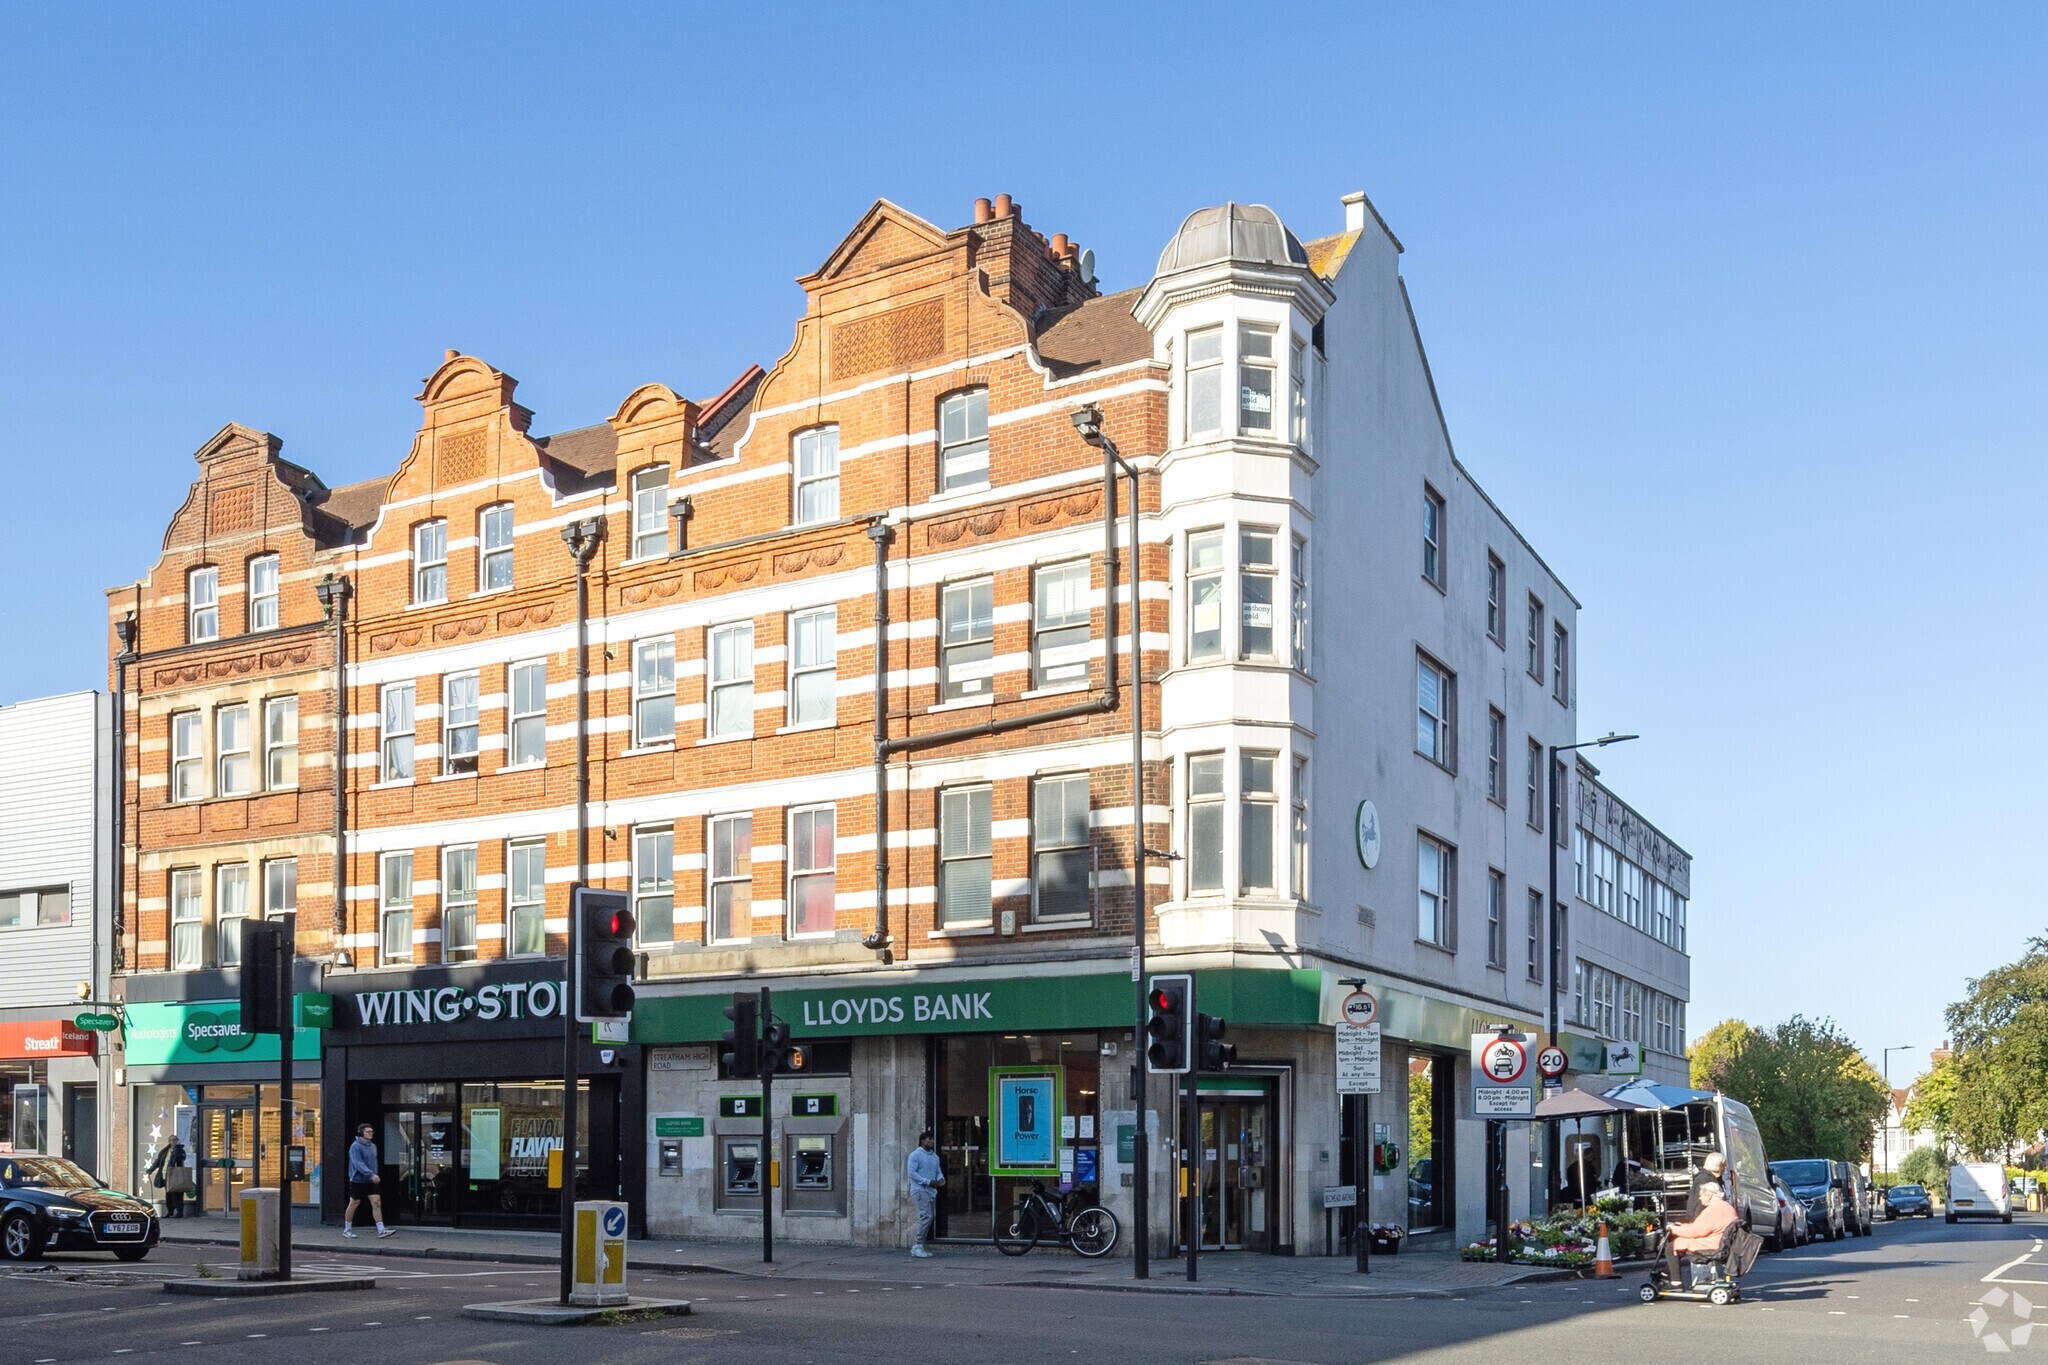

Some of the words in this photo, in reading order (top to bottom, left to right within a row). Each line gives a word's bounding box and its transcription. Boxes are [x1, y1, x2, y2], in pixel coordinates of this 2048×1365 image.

[1244, 604, 1270, 614] anthony
[1244, 612, 1258, 620] gold
[804, 996, 904, 1026] LLOYDS
[914, 992, 993, 1022] BANK
[80, 1016, 116, 1026] Specsavers
[62, 1032, 90, 1040] Iceland
[130, 1028, 178, 1040] Audiologists
[188, 1022, 247, 1040] Specsaver
[654, 1053, 691, 1061] STREATHAM
[692, 1052, 709, 1060] HIGH
[1542, 1054, 1562, 1066] 20
[654, 1062, 671, 1070] ROAD
[1015, 1132, 1040, 1140] Power
